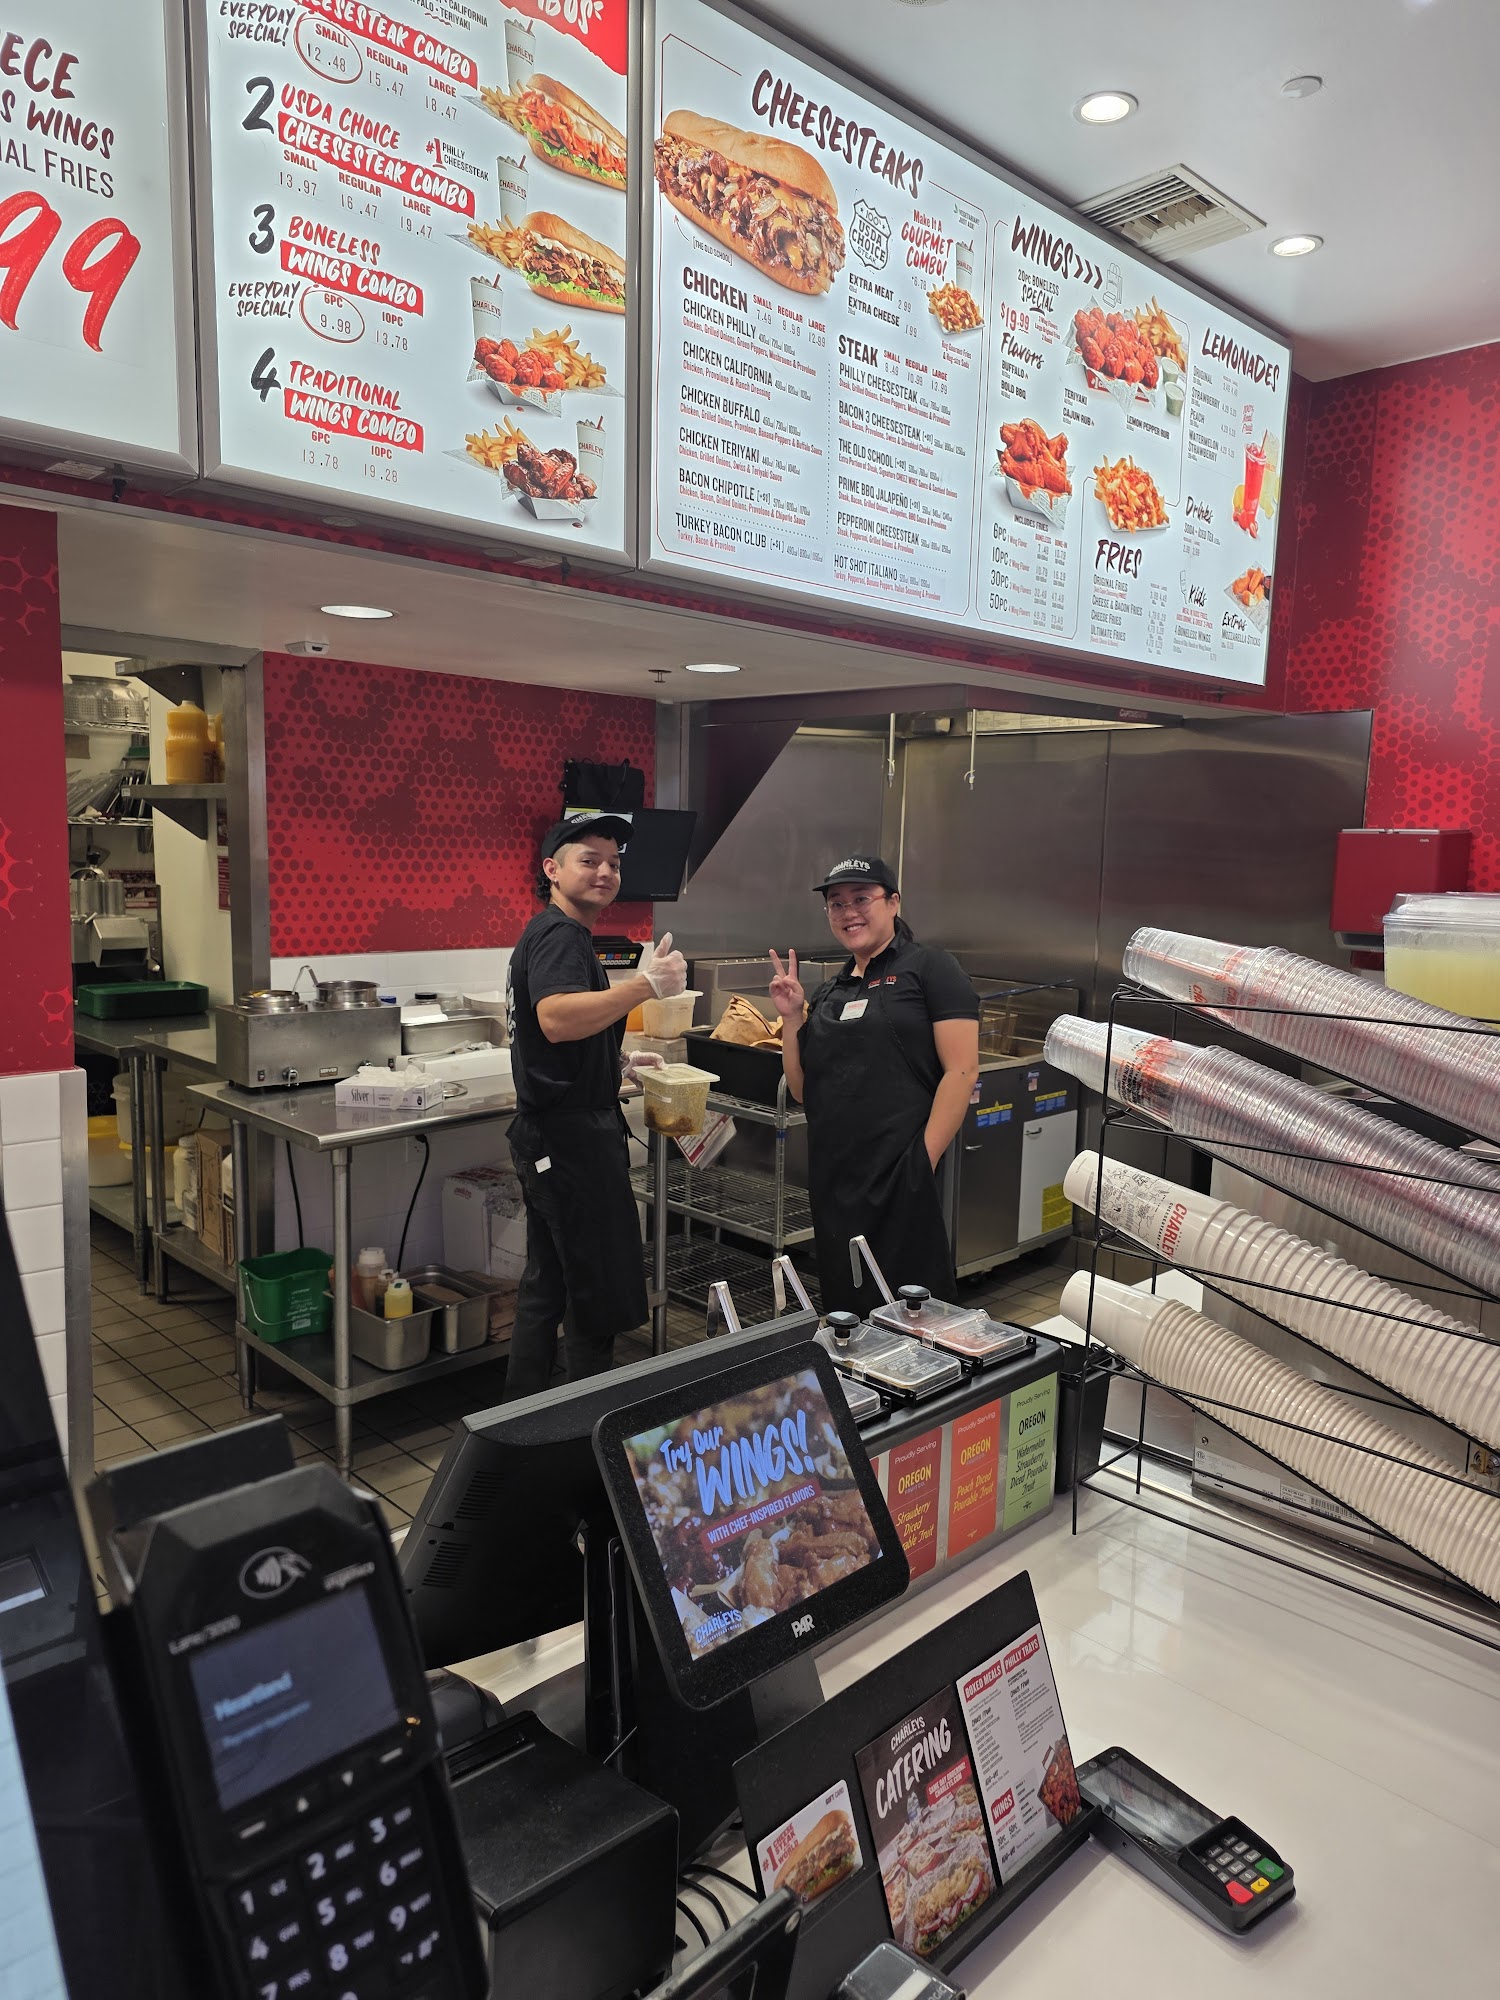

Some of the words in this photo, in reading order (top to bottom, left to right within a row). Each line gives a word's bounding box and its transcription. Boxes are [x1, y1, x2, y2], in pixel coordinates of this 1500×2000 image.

[220, 1, 296, 26] EVERYDAY
[440, 9, 471, 31] TERIYAKI
[448, 0, 488, 27] CALIFORNIA
[228, 20, 289, 47] SPECIAL!
[315, 23, 349, 48] SMALL
[366, 46, 408, 75] REGULAR
[413, 34, 471, 79] COMBO
[429, 76, 457, 98] LARGE
[242, 76, 275, 134] 2
[281, 83, 332, 124] USDA
[339, 107, 400, 150] CHOICE
[26, 99, 115, 160] WINGS
[751, 69, 924, 199] CHEESESTEAKS
[282, 117, 406, 184] CHEESESTEAK
[410, 165, 468, 210] COMBO
[283, 149, 318, 172] SMALL
[442, 142, 465, 160] PHILLY
[44, 148, 115, 199] FRIES
[443, 154, 489, 182] CHEESESTEAK
[338, 172, 382, 198] REGULAR
[402, 196, 431, 217] LARGE
[248, 203, 275, 254] 3
[288, 216, 381, 265] BONELESS
[859, 220, 882, 248] USDA
[913, 209, 930, 228] Make
[937, 220, 943, 233] A
[852, 229, 885, 263] CHOICE
[901, 221, 954, 259] GOURMET
[1011, 215, 1073, 280] WINGS
[287, 244, 352, 287] WINGS
[358, 268, 417, 308] COMBO
[906, 246, 948, 282] COMBO!
[228, 281, 300, 299] EVERYDAY
[683, 266, 748, 314] CHICKEN
[849, 273, 873, 292] EXTRA
[874, 284, 895, 302] MEAT
[1032, 273, 1060, 297] BONELESS
[236, 299, 294, 318] SPECIAL!
[323, 293, 344, 309] 6PC
[753, 294, 773, 310] SMALL
[777, 305, 803, 323] REGULAR
[808, 318, 826, 333] LARGE
[848, 296, 872, 316] EXTRA
[873, 307, 900, 327] CHEESE
[1021, 288, 1054, 312] SPECIAL
[382, 311, 404, 327] 10PC
[683, 298, 725, 327] CHICKEN
[726, 314, 757, 339] PHILLY
[683, 341, 722, 369] CHICKEN
[724, 356, 773, 387] CALIFORNIA
[838, 334, 878, 368] STEAK
[1000, 332, 1045, 370] Flavors
[1201, 328, 1280, 393] LEMONADES
[250, 347, 282, 403] 4
[289, 360, 402, 411] TRADITIONAL
[884, 350, 901, 363] SMALL
[905, 358, 928, 373] REGULAR
[932, 368, 948, 381] LARGE
[1001, 359, 1025, 379] BUFFALO
[839, 362, 867, 383] PHILLY
[867, 374, 918, 404] CHEESESTEAK
[1064, 388, 1088, 406] TERIYAKI
[681, 385, 720, 410] CHICKEN
[722, 398, 761, 423] BUFFALO
[1062, 407, 1080, 423] CAJUN
[288, 395, 352, 429] WINGS
[358, 410, 417, 445] COMBO
[838, 399, 864, 421] BACON
[865, 411, 871, 424] 3
[871, 412, 921, 441] CHEESESTEAK
[311, 432, 331, 445] 6PC
[371, 445, 393, 460] 10PC
[679, 427, 719, 452] CHICKEN
[721, 439, 760, 463] TERIYAKI
[838, 438, 852, 453] THE
[853, 443, 866, 460] OLD
[867, 449, 894, 468] SCHOOL
[679, 468, 710, 489] BACON
[712, 477, 755, 501] CHIPOTLE
[838, 475, 861, 494] PRIME
[861, 483, 875, 498] BBQ
[876, 488, 909, 509] JALAPEÑO
[1185, 495, 1213, 524] Drinks
[676, 512, 711, 535] TURKEY
[713, 522, 742, 543] BACON
[744, 531, 767, 548] CLUB
[837, 511, 875, 533] PEPPERONI
[876, 523, 920, 545] CHEESESTEAK
[993, 522, 1007, 542] 6PC
[834, 554, 848, 569] HOT
[849, 558, 868, 574] SHOT
[868, 563, 898, 581] ITALIANO
[992, 546, 1009, 566] 10PC
[1094, 538, 1143, 579] FRIES
[990, 569, 1009, 589] 30PC
[989, 593, 1008, 612] 50PC
[1189, 584, 1208, 607] Kids
[351, 1087, 370, 1103] Silver
[957, 1421, 976, 1434] Proudly
[977, 1411, 996, 1424] Serving
[1018, 1409, 1046, 1436] OREGON
[659, 1439, 693, 1475] Try
[693, 1426, 724, 1455] Our
[695, 1409, 816, 1517] WINGS!
[895, 1447, 916, 1465] Proudly
[916, 1441, 937, 1455] Serving
[960, 1437, 991, 1466] OREGON
[1016, 1438, 1045, 1460] Watermelon
[1016, 1452, 1044, 1473] Strawberry
[898, 1464, 932, 1495] OREGON
[956, 1481, 974, 1498] Peach
[975, 1467, 993, 1485] Diced
[1010, 1474, 1026, 1490] Diced
[707, 1522, 729, 1546] WITH
[729, 1498, 785, 1536] CHEF-INSPIRED
[784, 1484, 817, 1514] FLAVORS
[896, 1500, 932, 1527] Strawberry
[953, 1492, 979, 1514] Pourable
[903, 1518, 923, 1537] Diced
[695, 1609, 743, 1644] CHARLEYS
[791, 1613, 816, 1639] PAR
[1005, 1651, 1022, 1670] PHILLY
[1021, 1638, 1039, 1657] TRAYS
[965, 1678, 985, 1700] BOXED
[983, 1664, 1001, 1685] MEALS
[890, 1716, 926, 1751] CHARLEYS
[875, 1717, 951, 1820] CATERING
[992, 1794, 1013, 1821] WINGS
[369, 1816, 388, 1844] 3
[306, 1852, 326, 1880] 2
[762, 1845, 778, 1873] #1
[379, 1861, 397, 1886] 6
[240, 1890, 255, 1915] 1
[317, 1897, 336, 1926] 5
[388, 1905, 407, 1932] 9
[250, 1936, 269, 1960] 4
[329, 1943, 349, 1971] 8
